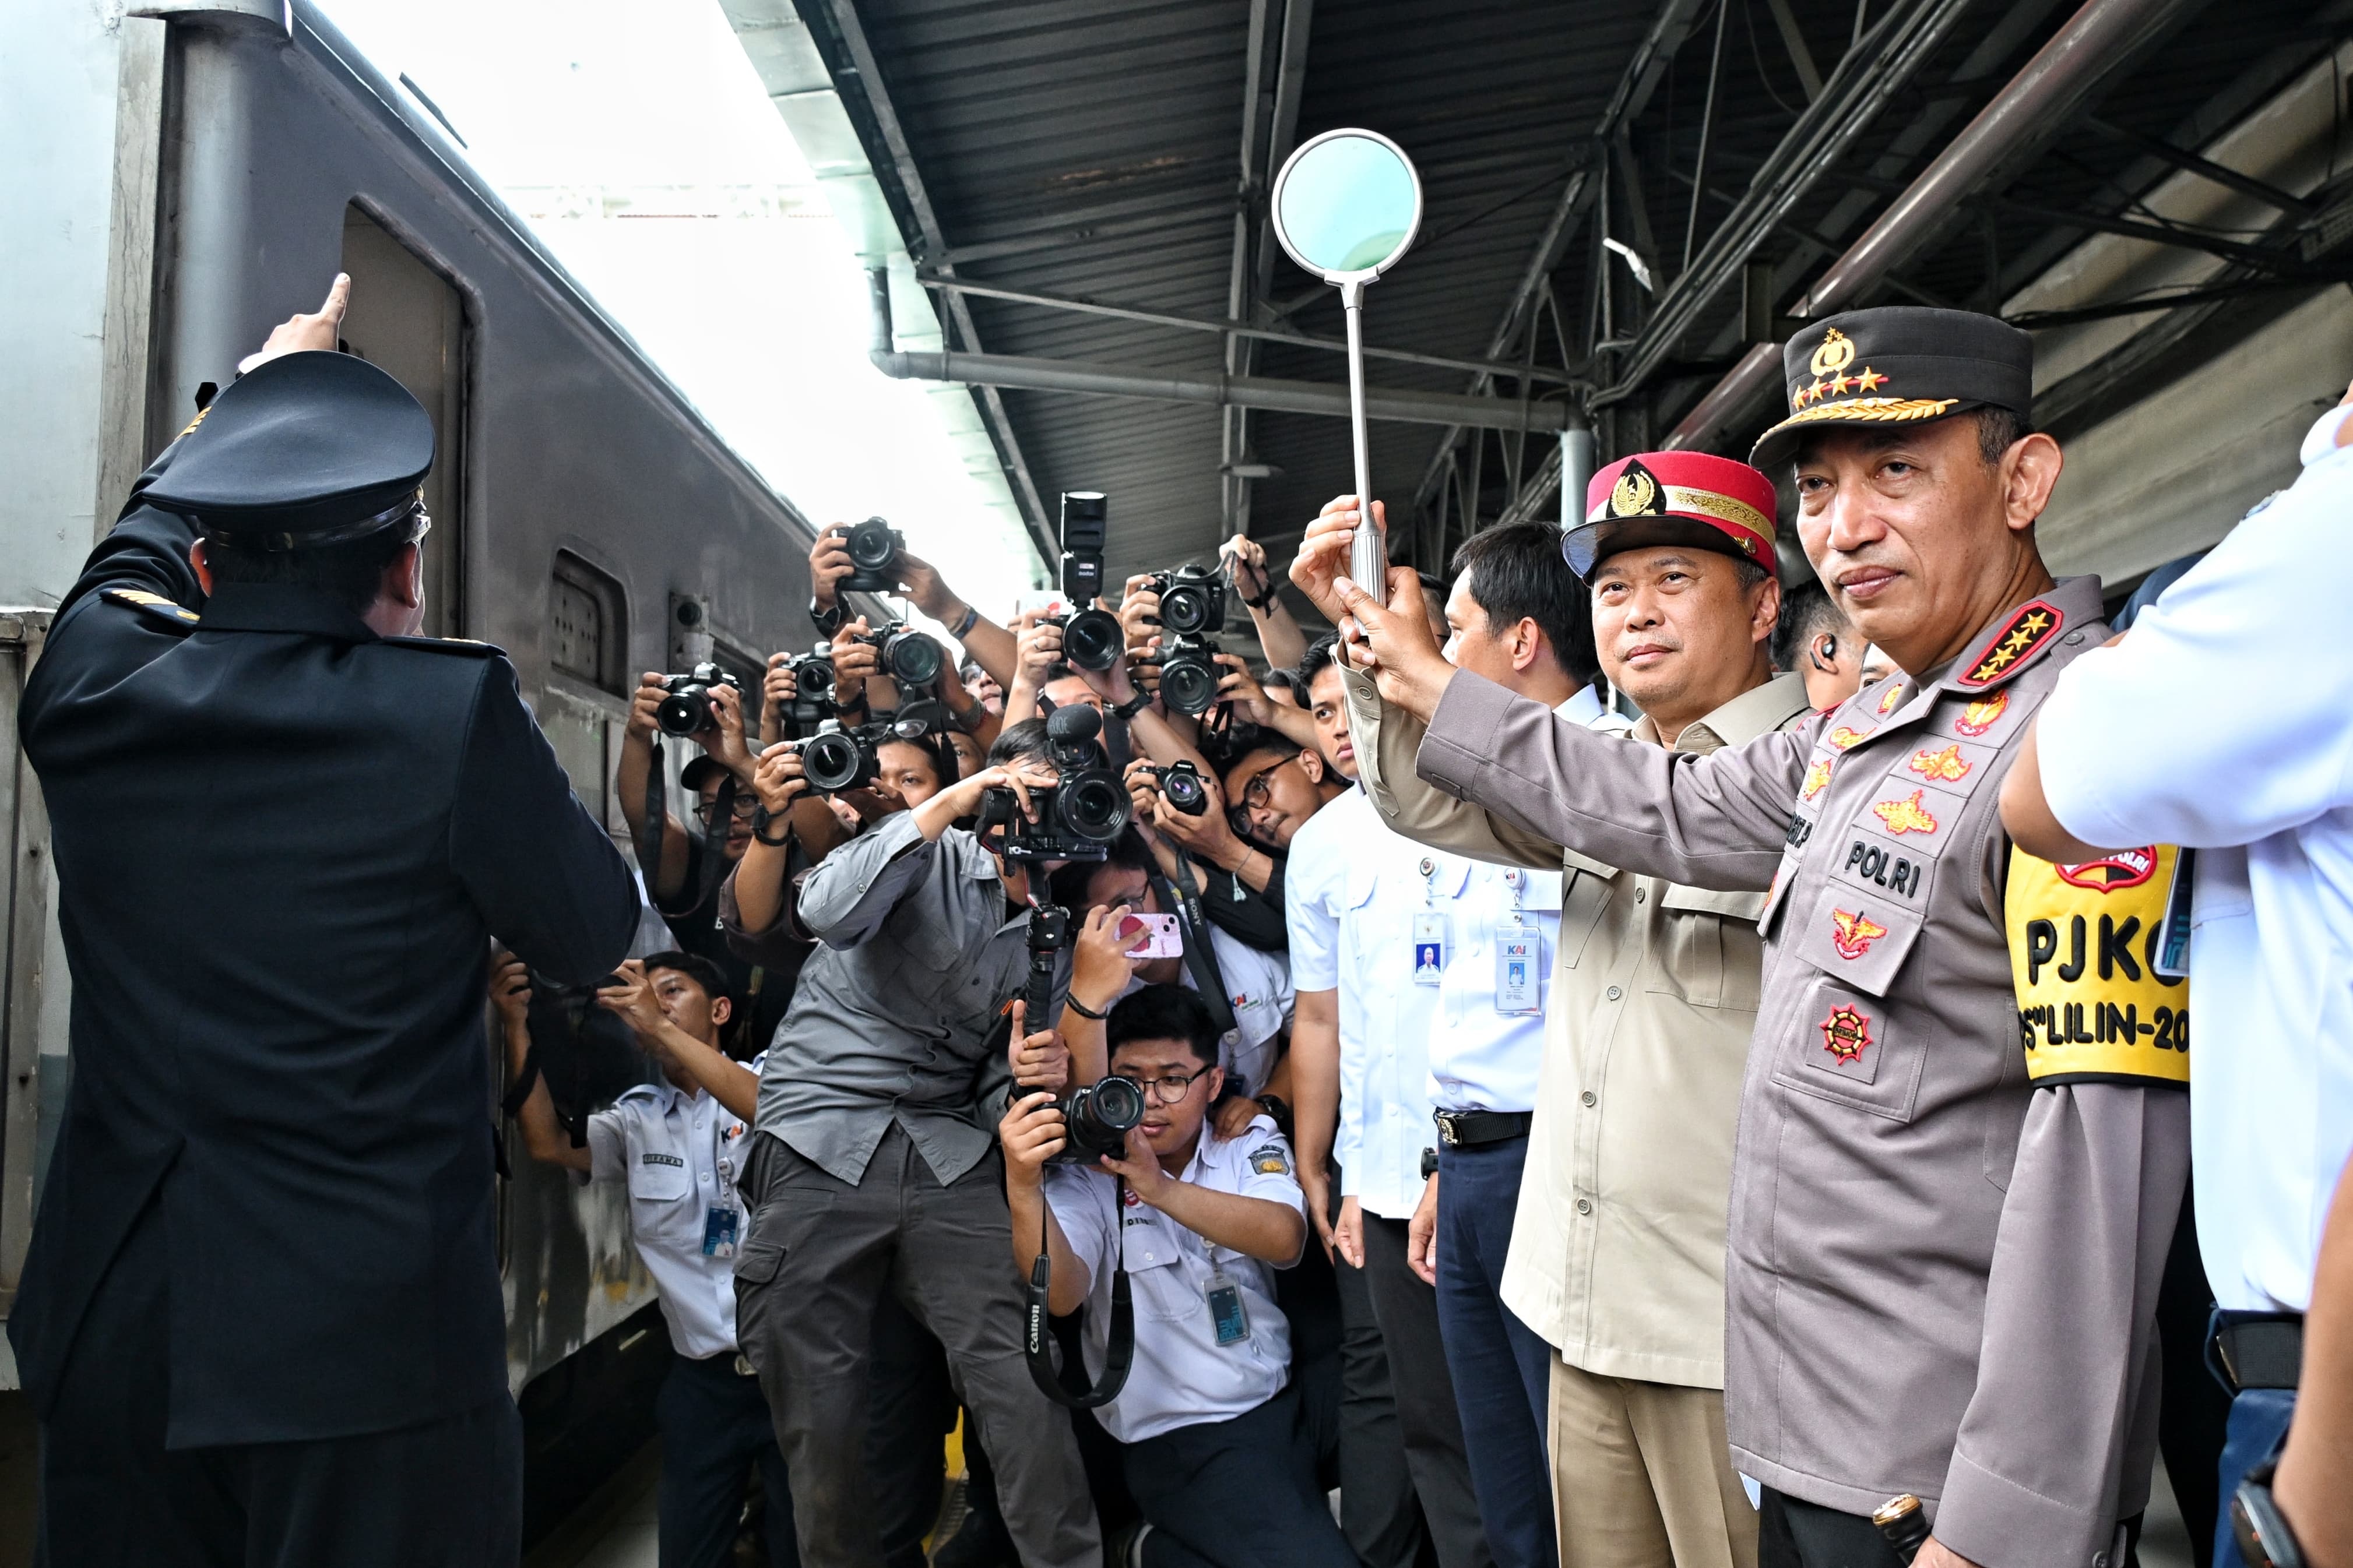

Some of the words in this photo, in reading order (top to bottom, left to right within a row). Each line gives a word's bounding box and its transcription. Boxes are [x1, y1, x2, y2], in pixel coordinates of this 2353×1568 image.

[1845, 840, 1921, 898] POLRI
[1188, 897, 1202, 926] SONY
[1507, 945, 1527, 954] KAI
[1030, 1305, 1040, 1354] Canon
